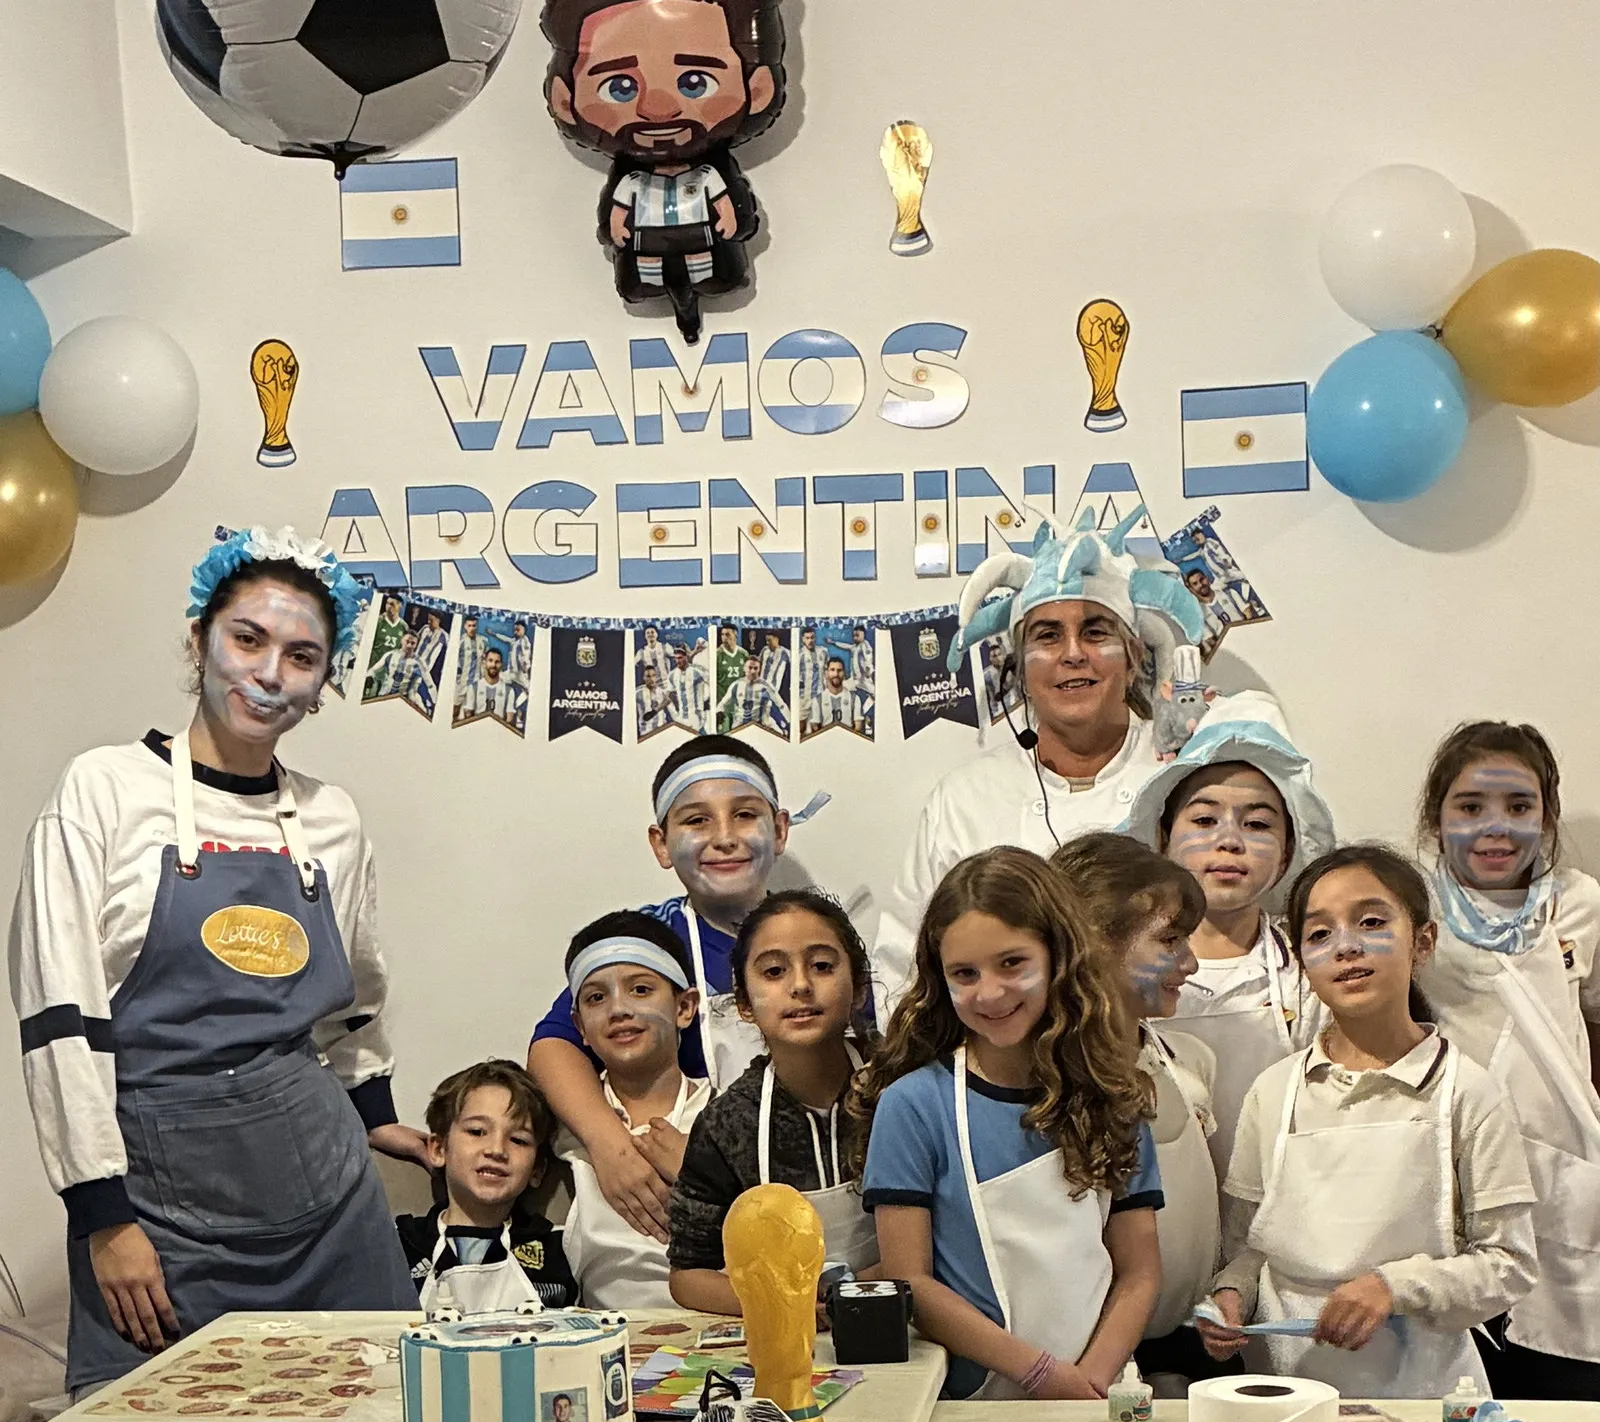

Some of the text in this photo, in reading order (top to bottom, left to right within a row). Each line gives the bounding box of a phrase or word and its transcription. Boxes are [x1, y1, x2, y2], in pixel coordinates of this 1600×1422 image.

[418, 321, 970, 451] VAMOS
[319, 463, 1167, 590] ARGENTINA
[384, 635, 397, 648] 23
[727, 665, 740, 678] 23
[912, 680, 957, 694] VAMO
[564, 689, 608, 700] VAMOS
[551, 698, 620, 711] ARGENTINA
